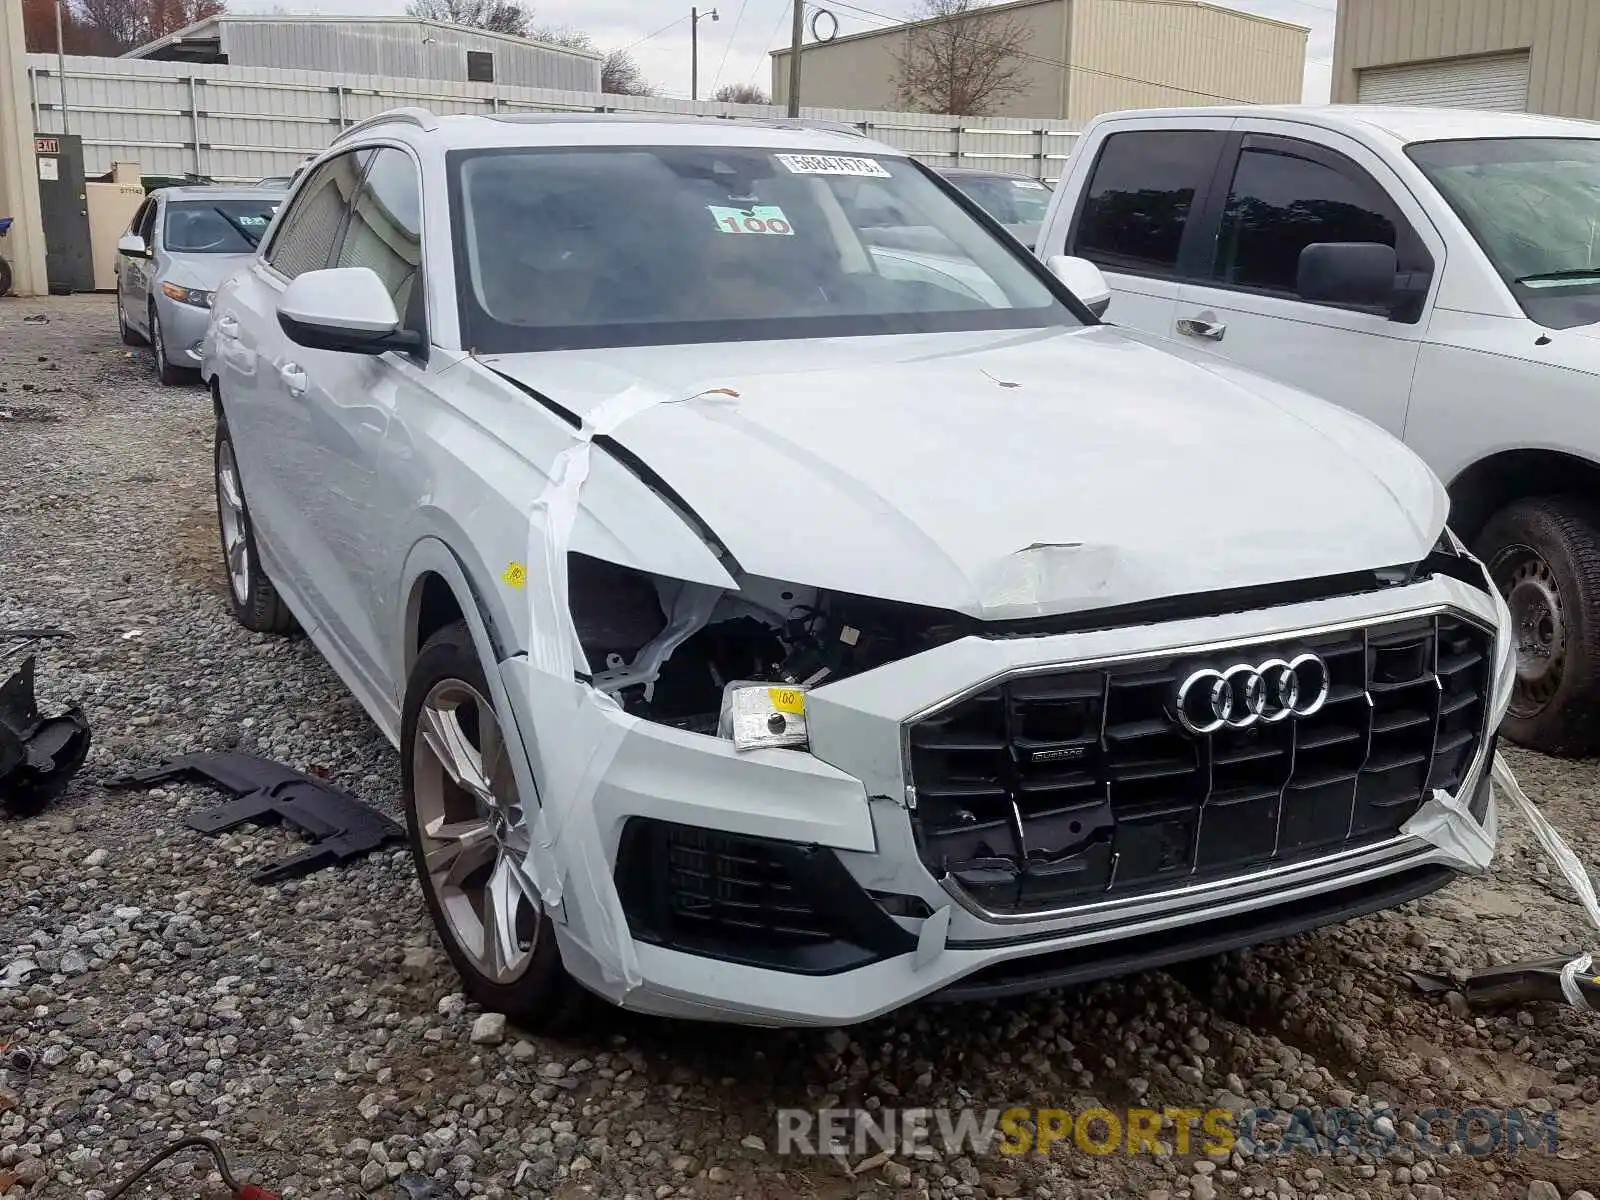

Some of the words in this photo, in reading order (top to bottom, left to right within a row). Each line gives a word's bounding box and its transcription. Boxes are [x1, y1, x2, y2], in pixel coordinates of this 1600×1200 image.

[37, 139, 57, 152] EXIT
[721, 217, 790, 233] 100
[779, 691, 795, 705] 100
